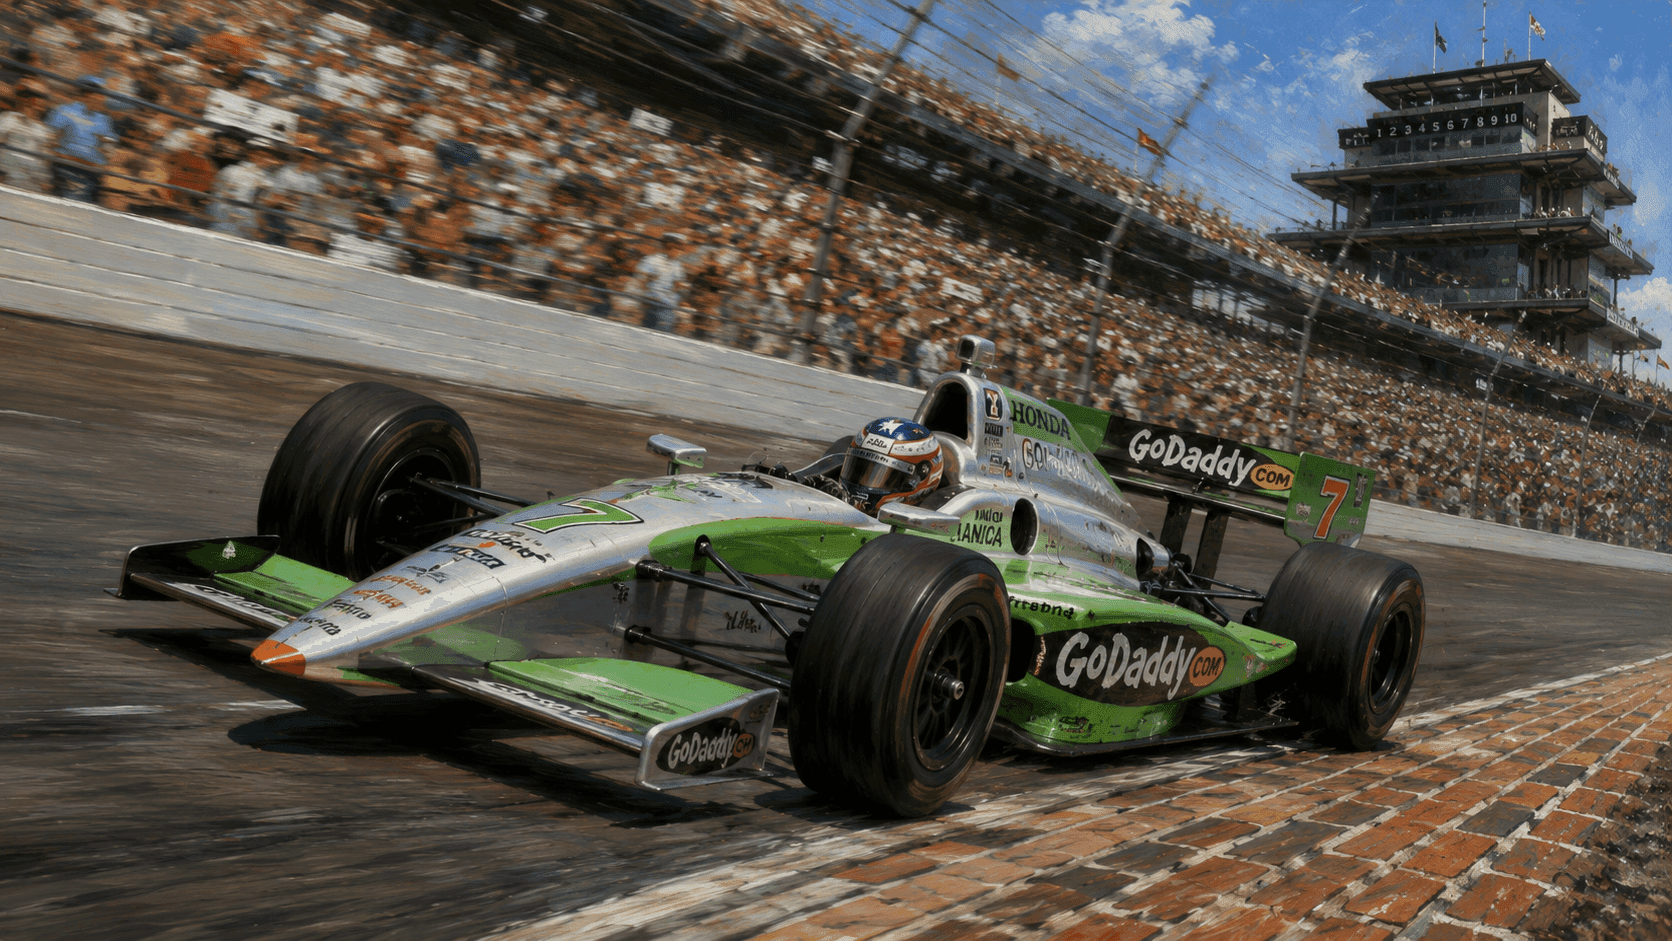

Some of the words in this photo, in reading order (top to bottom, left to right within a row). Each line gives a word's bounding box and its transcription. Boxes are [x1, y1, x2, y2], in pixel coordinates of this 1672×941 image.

[1389, 127, 1398, 137] 2
[1404, 125, 1413, 135] 3
[1418, 123, 1427, 133] 4
[1432, 121, 1441, 132] 5
[1446, 120, 1455, 130] 6
[1461, 118, 1469, 129] 7
[1476, 117, 1485, 127] 8
[1490, 115, 1499, 126] 9
[1504, 113, 1518, 124] 10
[1010, 401, 1072, 440] HONDA
[1128, 428, 1257, 487] GoDaddy
[1255, 468, 1291, 487] COM
[512, 497, 645, 534] 7
[1312, 474, 1350, 540] 7
[1055, 631, 1197, 701] GoDaddy
[1192, 656, 1222, 679] COM
[667, 727, 739, 770] GoDaddy
